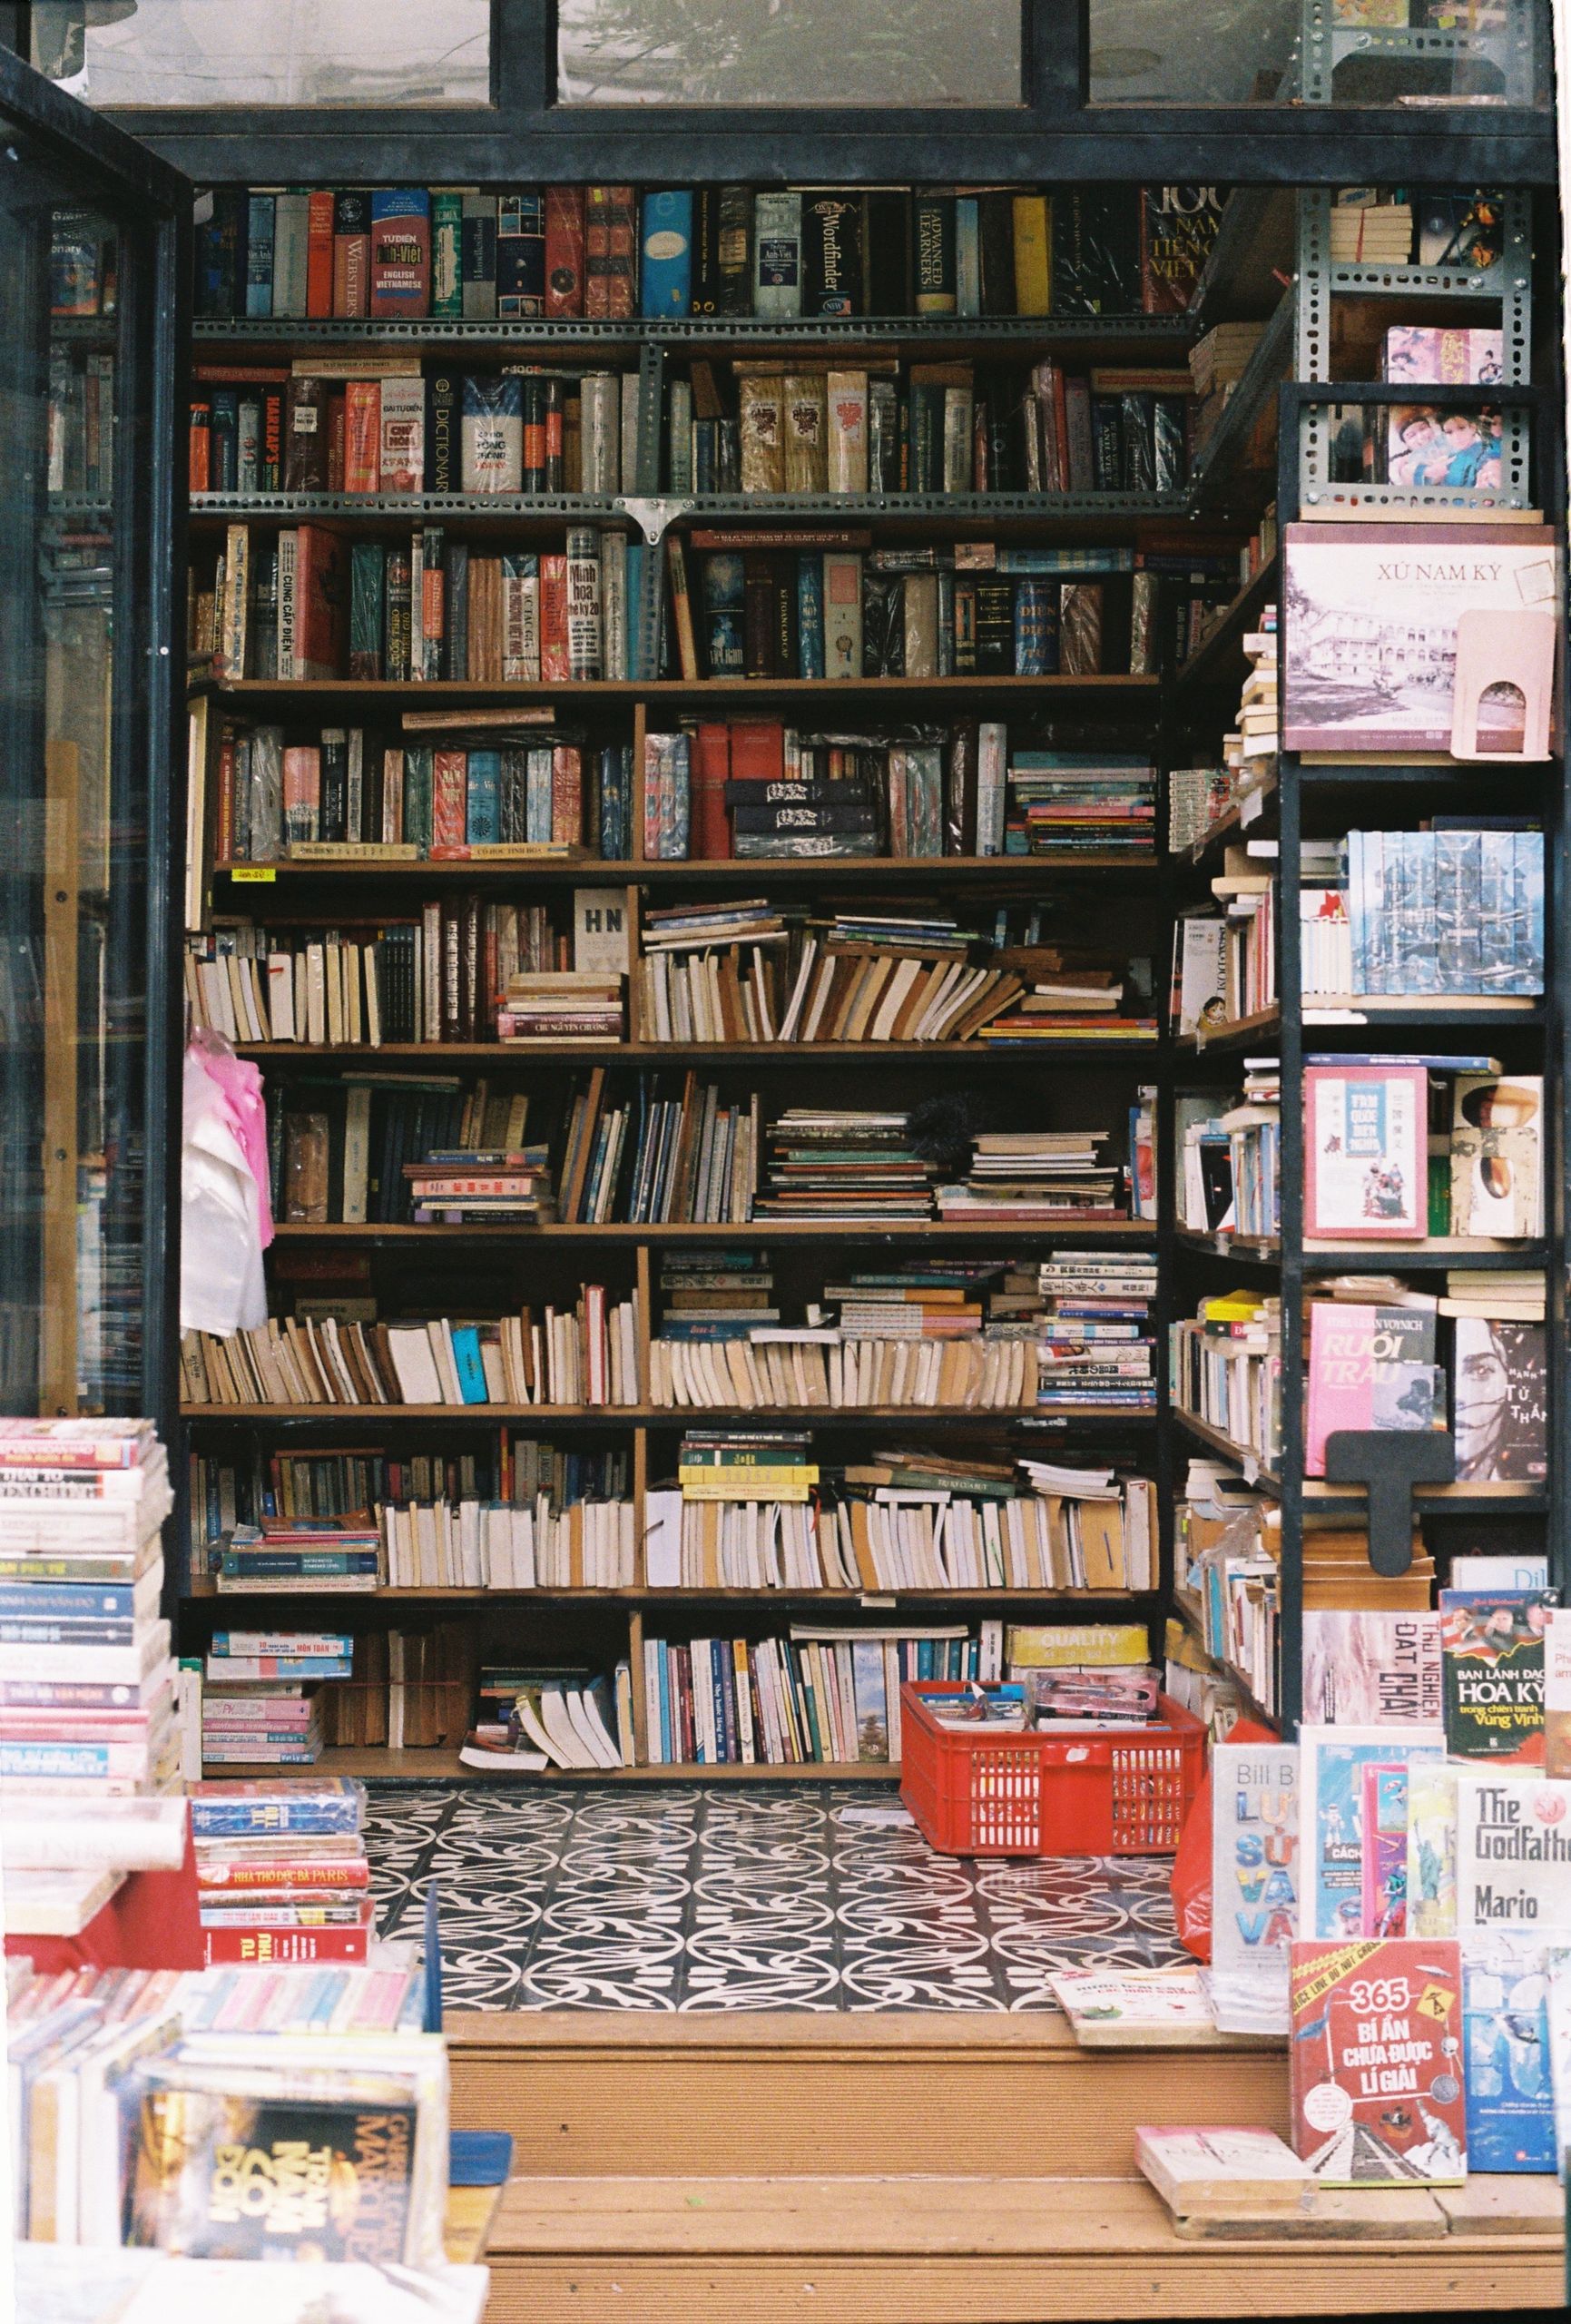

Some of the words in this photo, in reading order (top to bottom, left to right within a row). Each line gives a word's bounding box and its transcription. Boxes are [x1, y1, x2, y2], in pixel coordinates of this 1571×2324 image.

[823, 214, 842, 290] Wordfinder
[919, 214, 932, 286] LEARNER'S
[932, 214, 943, 286] ADVANCED
[347, 240, 362, 318] WEBSTER'S
[376, 281, 422, 289] VIETNAMESE
[384, 271, 415, 280] ENGLISH
[827, 302, 842, 310] NEW
[569, 565, 596, 583] Minh
[1416, 564, 1467, 581] NAM
[283, 575, 292, 602] CUNG
[589, 603, 599, 615] 20
[585, 909, 622, 932] HN
[1234, 1325, 1244, 1335] D
[1041, 1633, 1118, 1647] QUALITY
[1458, 1669, 1484, 1680] BAN
[1458, 1682, 1513, 1703] HOA
[1459, 1705, 1486, 1715] trong
[1514, 1704, 1538, 1713] tranh
[1236, 1764, 1271, 1786] Bill
[1280, 1766, 1295, 1785] B
[1236, 1789, 1299, 1824] LƯ
[1476, 1787, 1521, 1824] The
[311, 1868, 349, 1882] PARIS
[1475, 1885, 1538, 1919] Mario
[1310, 1976, 1329, 1995] LINE
[1329, 1967, 1340, 1982] DO
[1340, 1955, 1357, 1971] NOT
[1350, 1976, 1410, 2014] 365
[1357, 2017, 1379, 2043] BÍ
[1341, 2043, 1388, 2068] CHƯA
[1360, 2066, 1379, 2094] LÍ
[1380, 2063, 1418, 2093] GIẢI
